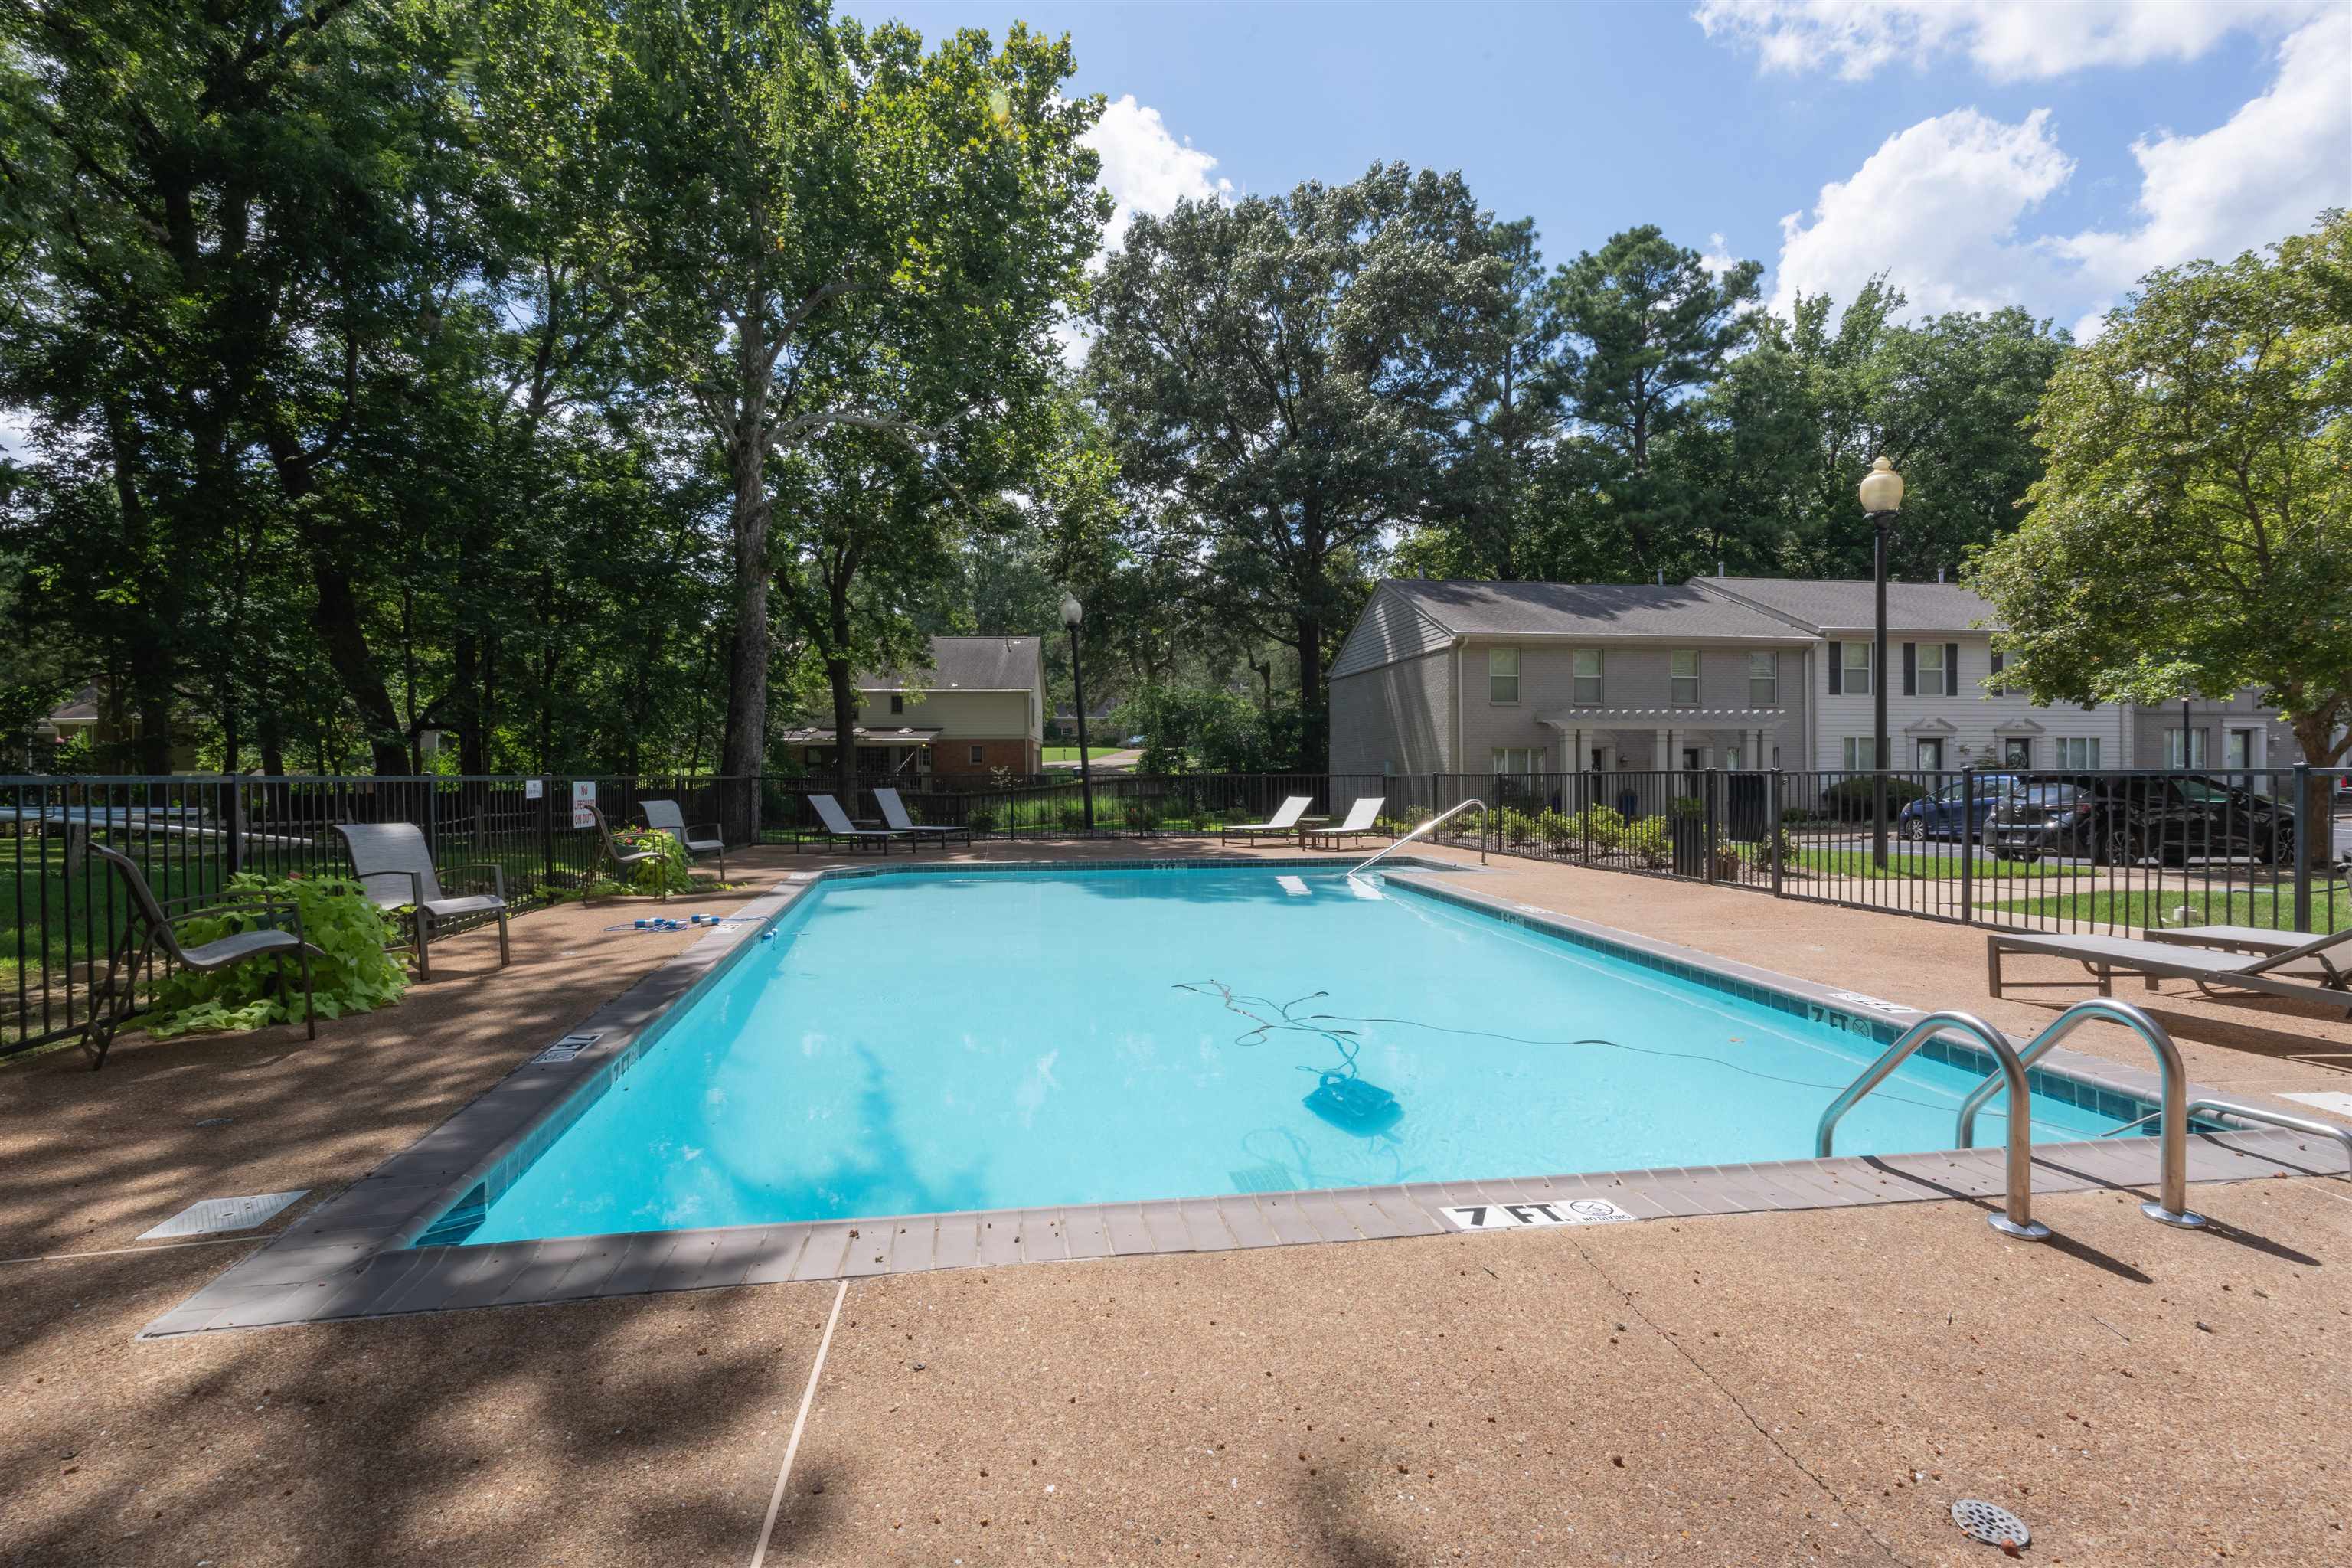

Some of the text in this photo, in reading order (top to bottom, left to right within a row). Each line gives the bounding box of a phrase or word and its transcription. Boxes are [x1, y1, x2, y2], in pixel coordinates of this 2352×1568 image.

[580, 785, 589, 796] NO
[1811, 1006, 1849, 1031] 7 FT
[1453, 1203, 1572, 1227] 7 FT.
